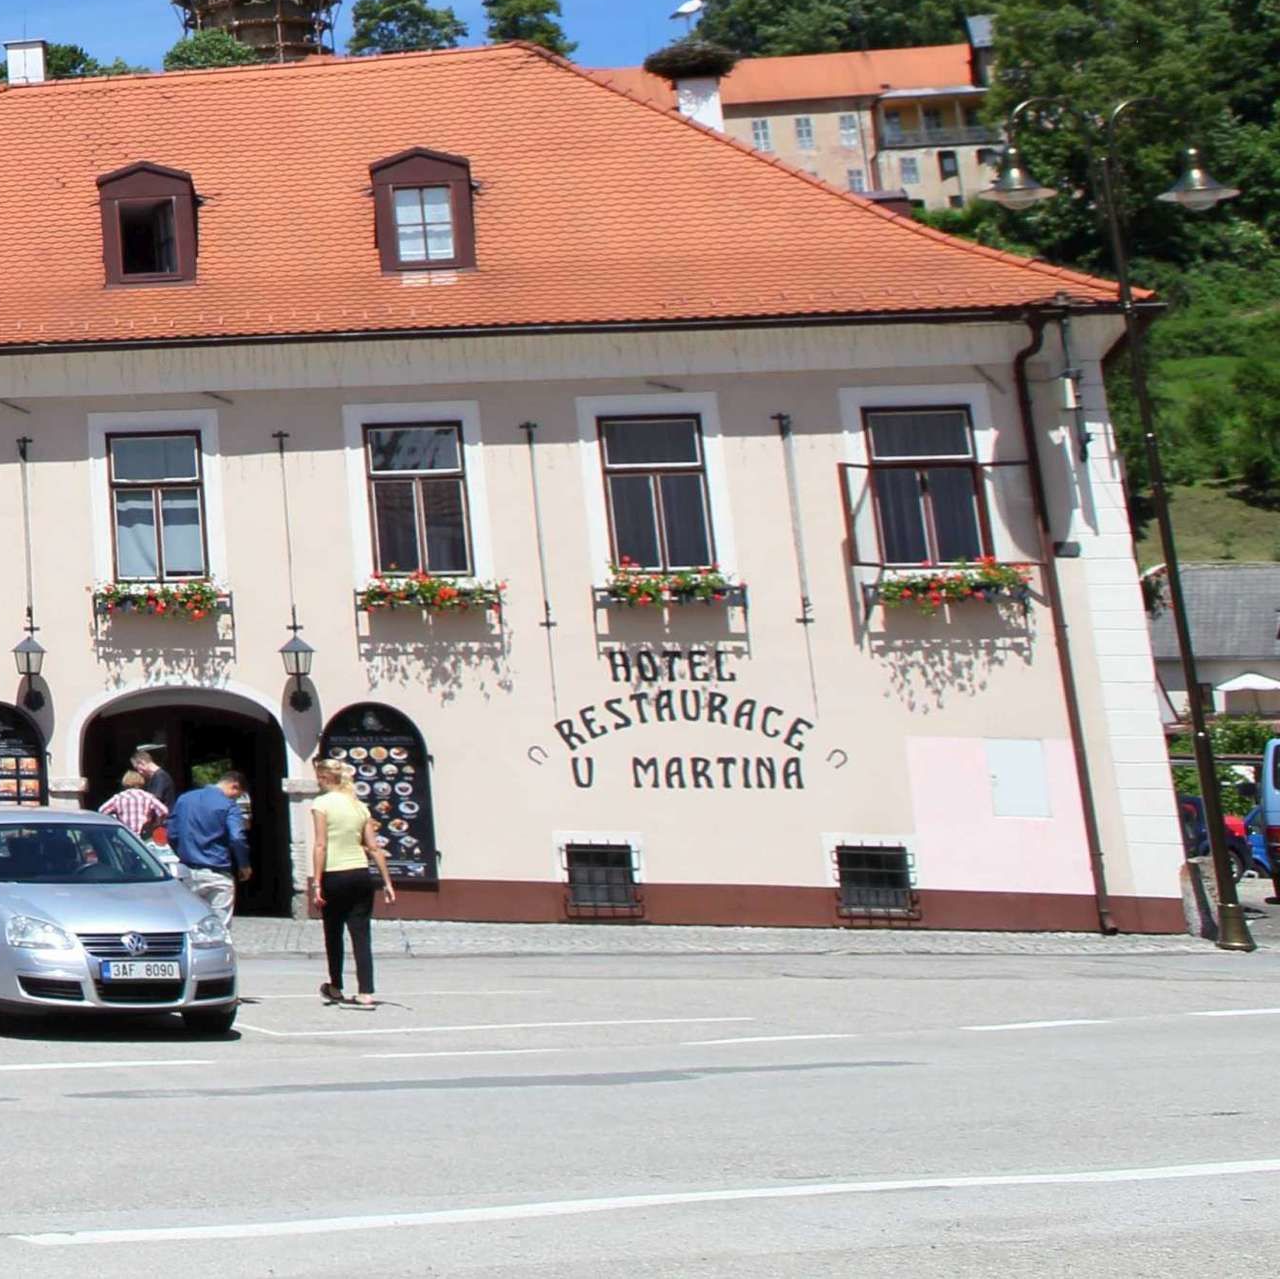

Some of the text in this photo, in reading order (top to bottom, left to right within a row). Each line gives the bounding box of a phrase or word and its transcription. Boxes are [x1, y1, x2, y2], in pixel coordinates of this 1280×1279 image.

[608, 651, 736, 682] HOTEL
[554, 689, 814, 751] RESTAURACE
[571, 757, 805, 789] U MARTINA
[112, 963, 175, 977] 3AF 8090
